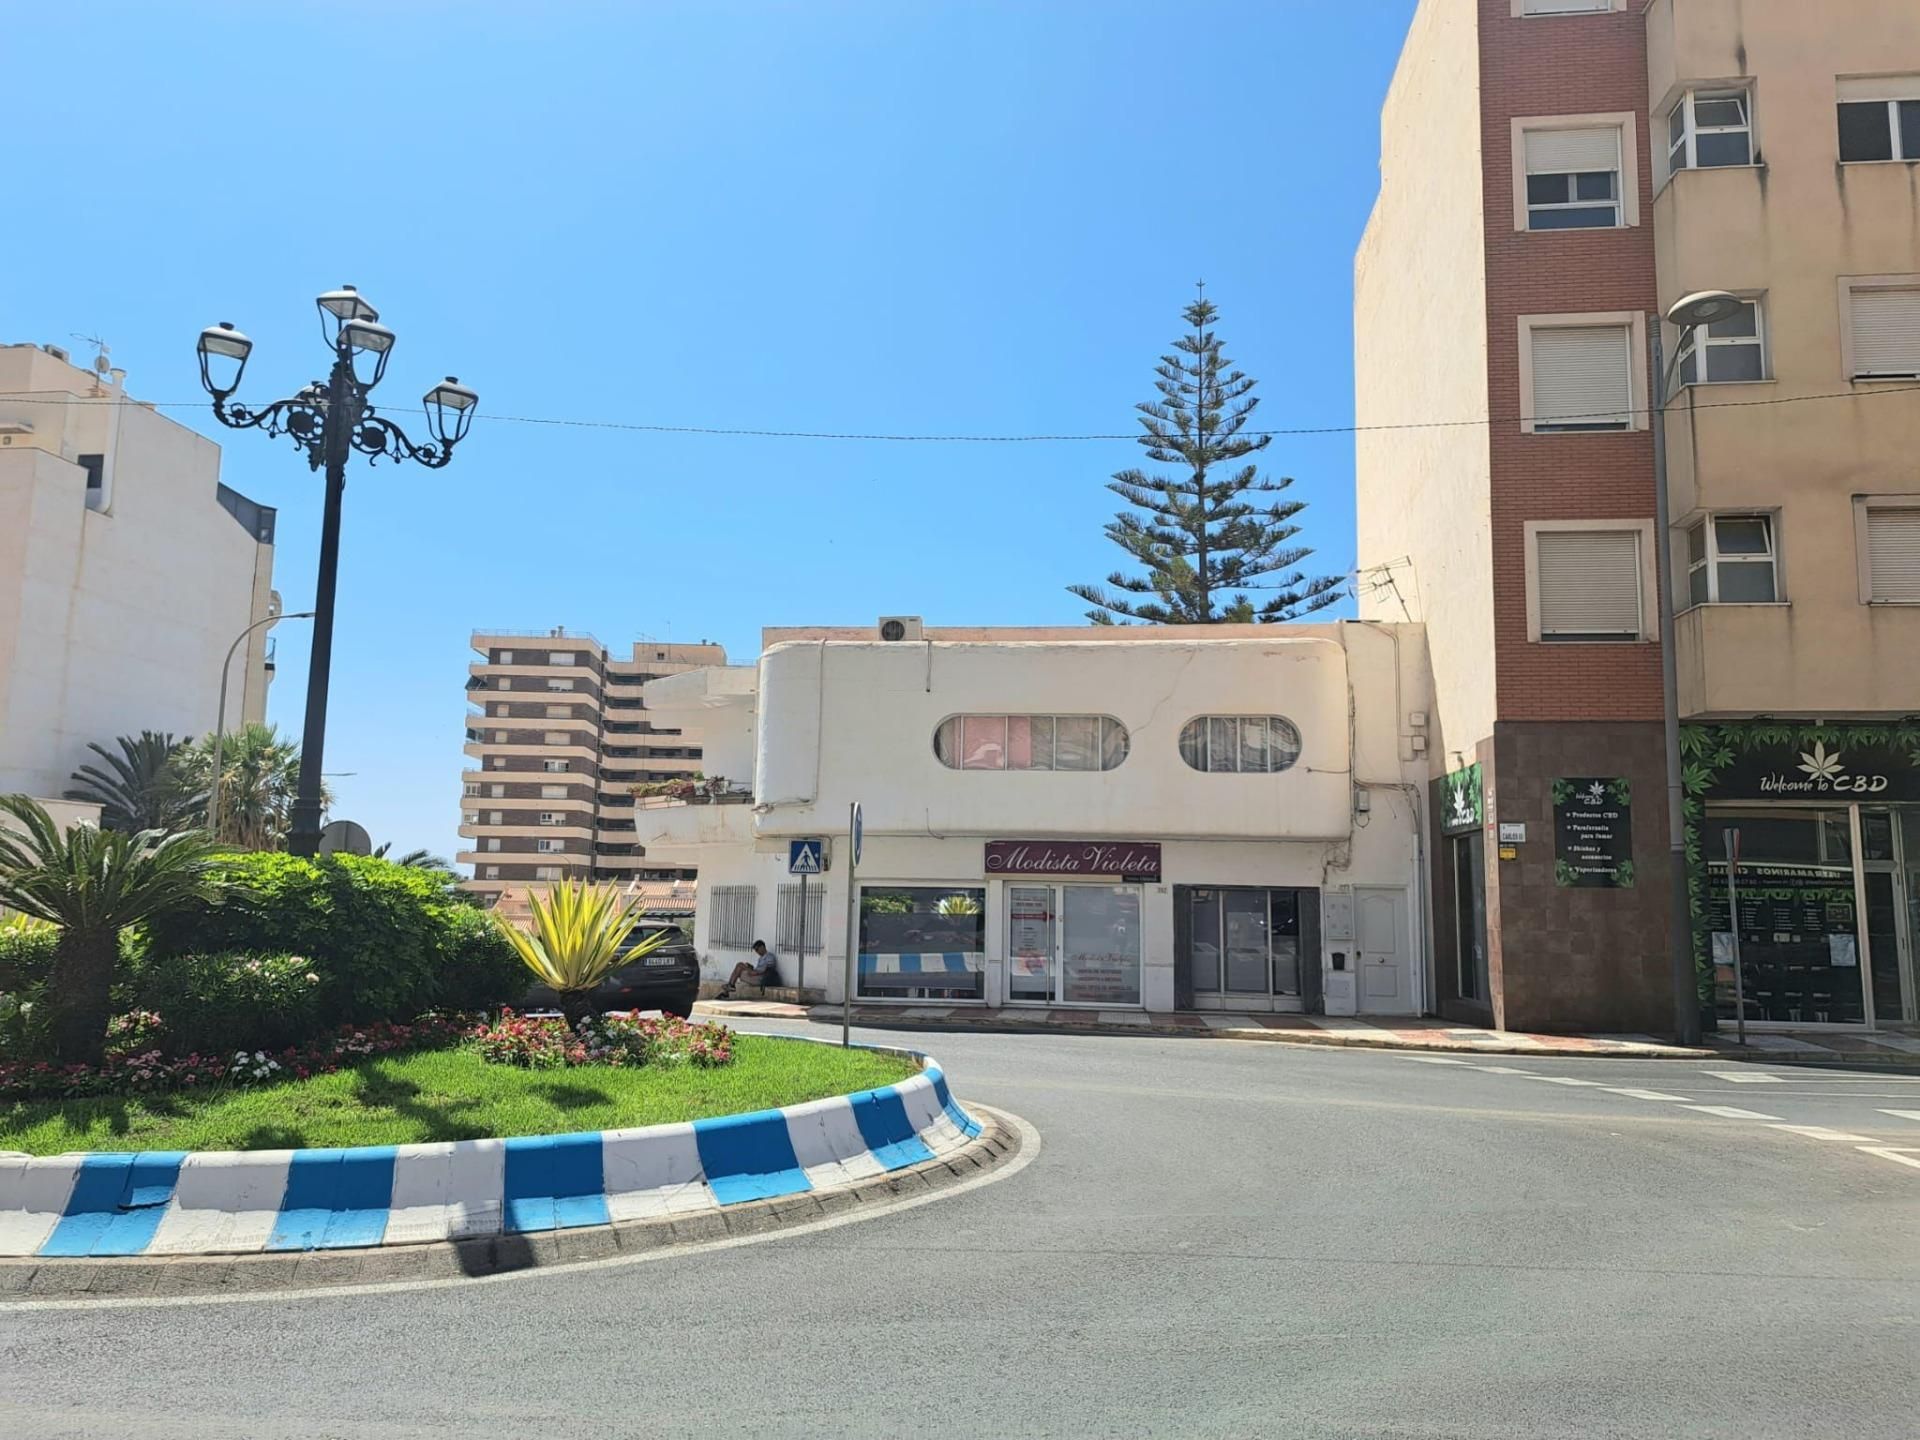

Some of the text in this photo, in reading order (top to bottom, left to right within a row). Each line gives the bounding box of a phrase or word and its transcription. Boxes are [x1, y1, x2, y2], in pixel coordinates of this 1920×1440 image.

[1760, 771, 1888, 794] Welcome to CBD
[986, 846, 1158, 871] Modista Violeta
